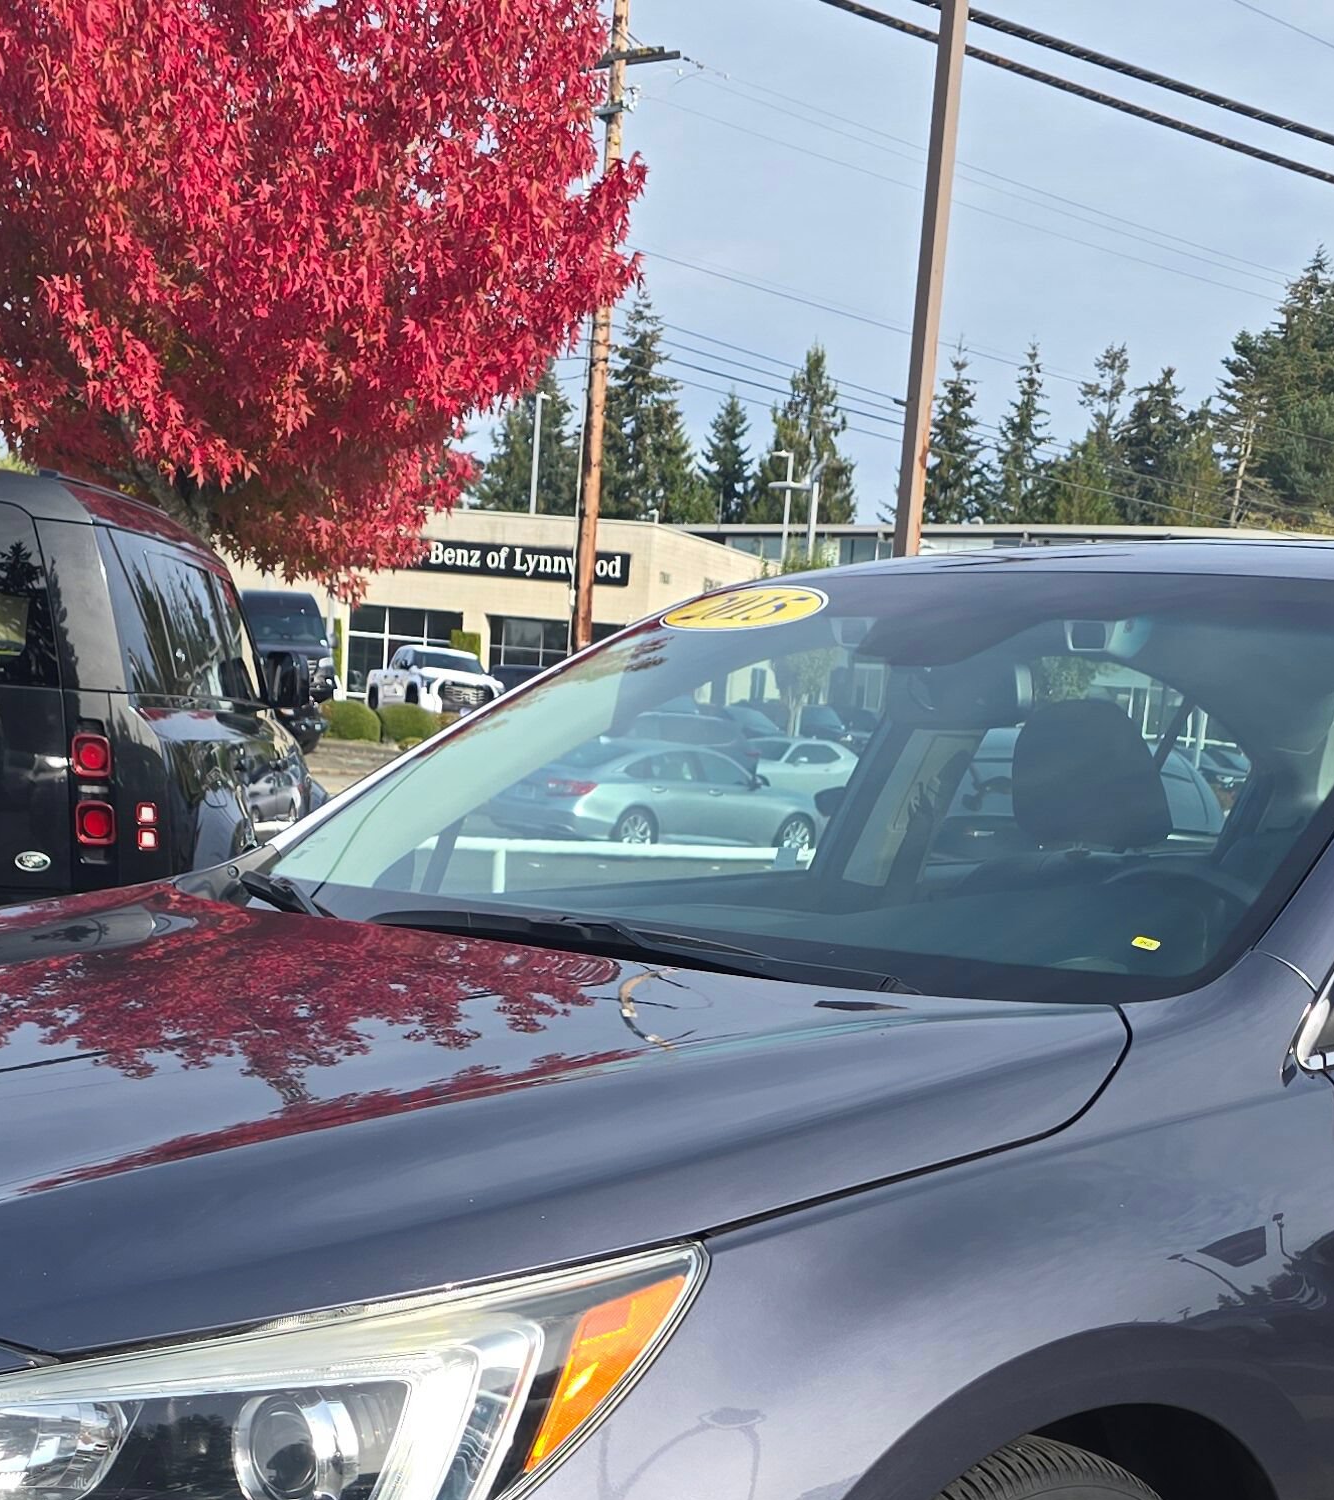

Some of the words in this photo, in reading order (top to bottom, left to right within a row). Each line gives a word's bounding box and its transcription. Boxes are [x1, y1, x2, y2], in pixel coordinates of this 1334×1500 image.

[429, 541, 481, 568] Benz
[487, 546, 510, 569] of
[513, 547, 621, 578] Lynnod
